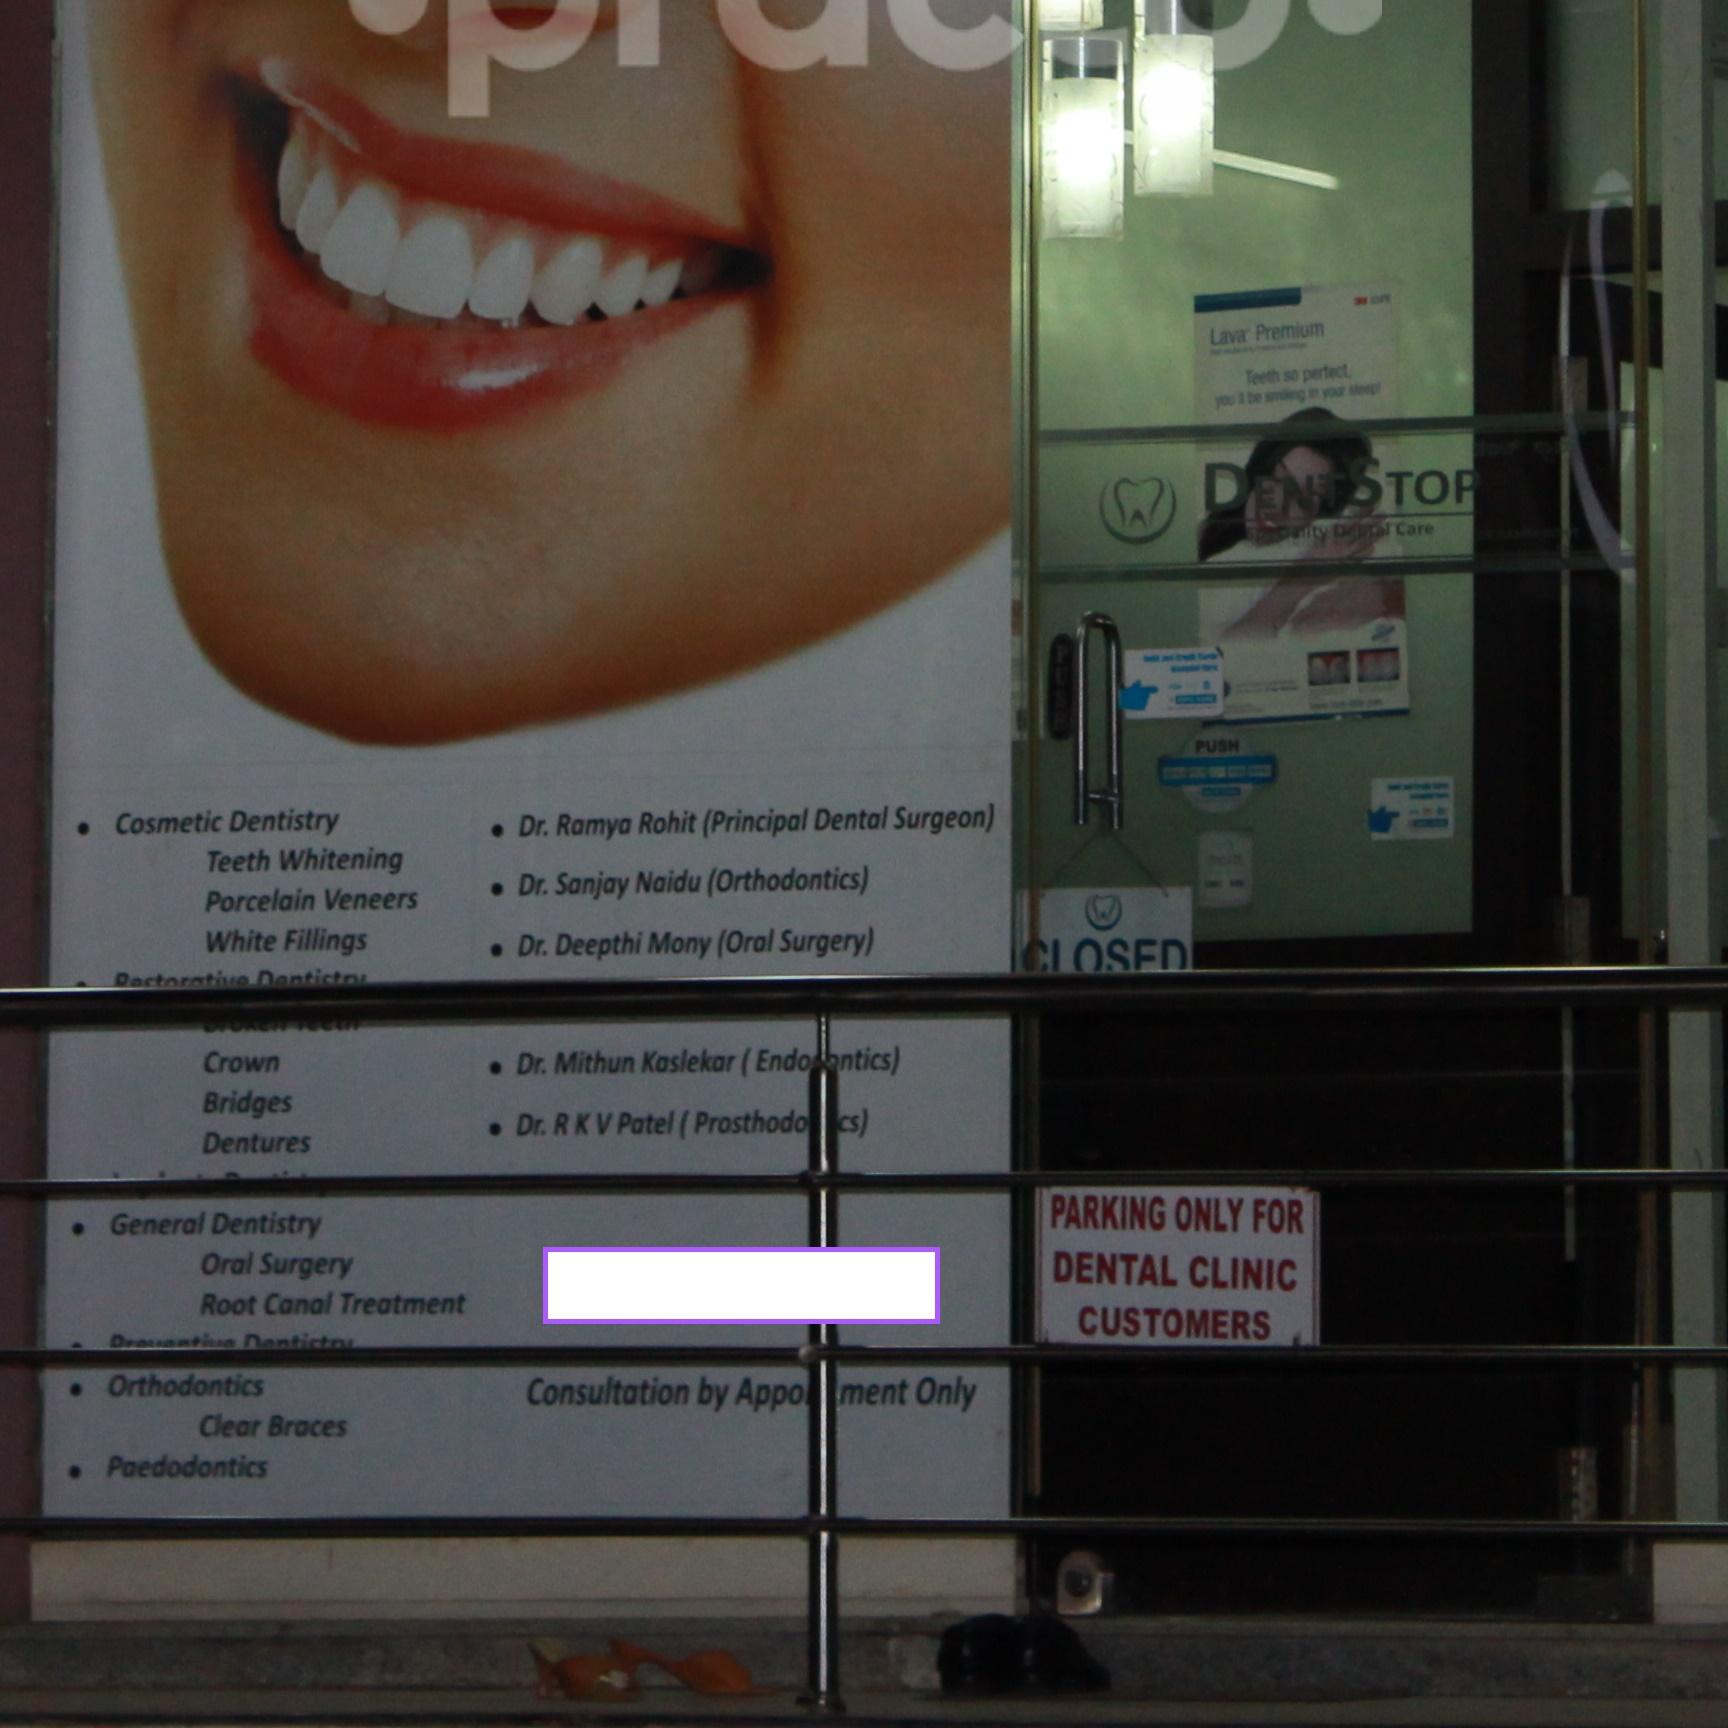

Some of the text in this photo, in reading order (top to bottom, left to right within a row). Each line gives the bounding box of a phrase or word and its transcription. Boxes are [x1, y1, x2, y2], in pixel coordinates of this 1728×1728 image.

[1255, 322, 1325, 343] Premium
[1395, 521, 1436, 537] Care
[1194, 738, 1240, 754] PUSH
[115, 808, 340, 837] Cosmetic Dentistry
[518, 803, 995, 841] Dr. Ramya Rohit (Principal Dental Surgeon)
[207, 847, 404, 875] Teeth Whitening
[518, 865, 869, 901] Dr. Sanjay Naidu (Orthodontics)
[205, 888, 419, 913] Porcelain Veneers
[205, 927, 368, 956] White Fillings
[518, 926, 874, 961] Dr. Deepthi Mony (Oral Surgery)
[1021, 938, 1187, 972] CLOSED
[203, 1050, 280, 1074] Crown
[516, 1052, 547, 1076] Dr.
[554, 1050, 636, 1074] Mithun
[642, 1049, 736, 1073] Kaslekar
[755, 1045, 901, 1076] Endoontics)
[202, 1090, 293, 1119] Bridges
[516, 1112, 547, 1136] Dr.
[553, 1112, 569, 1135] R
[575, 1112, 596, 1135] K
[596, 1112, 613, 1134] V
[616, 1110, 675, 1135] Patel
[694, 1108, 870, 1139] Prosthodocs)
[202, 1131, 312, 1156] Dentures
[110, 1212, 322, 1239] General Dentistry
[1050, 1194, 1305, 1235] PARKING ONLY FOR
[201, 1252, 354, 1280] Oral Surgery
[1053, 1250, 1298, 1293] DENTAL CLINIC
[200, 1291, 467, 1317] Root Canal Treatment
[1078, 1306, 1271, 1343] CUSTOMERS
[107, 1373, 265, 1398] Orthodontics
[526, 1375, 978, 1413] Consultation by Appoment Only
[199, 1413, 348, 1438] Clear Braces
[107, 1454, 269, 1480] Paedodontics
